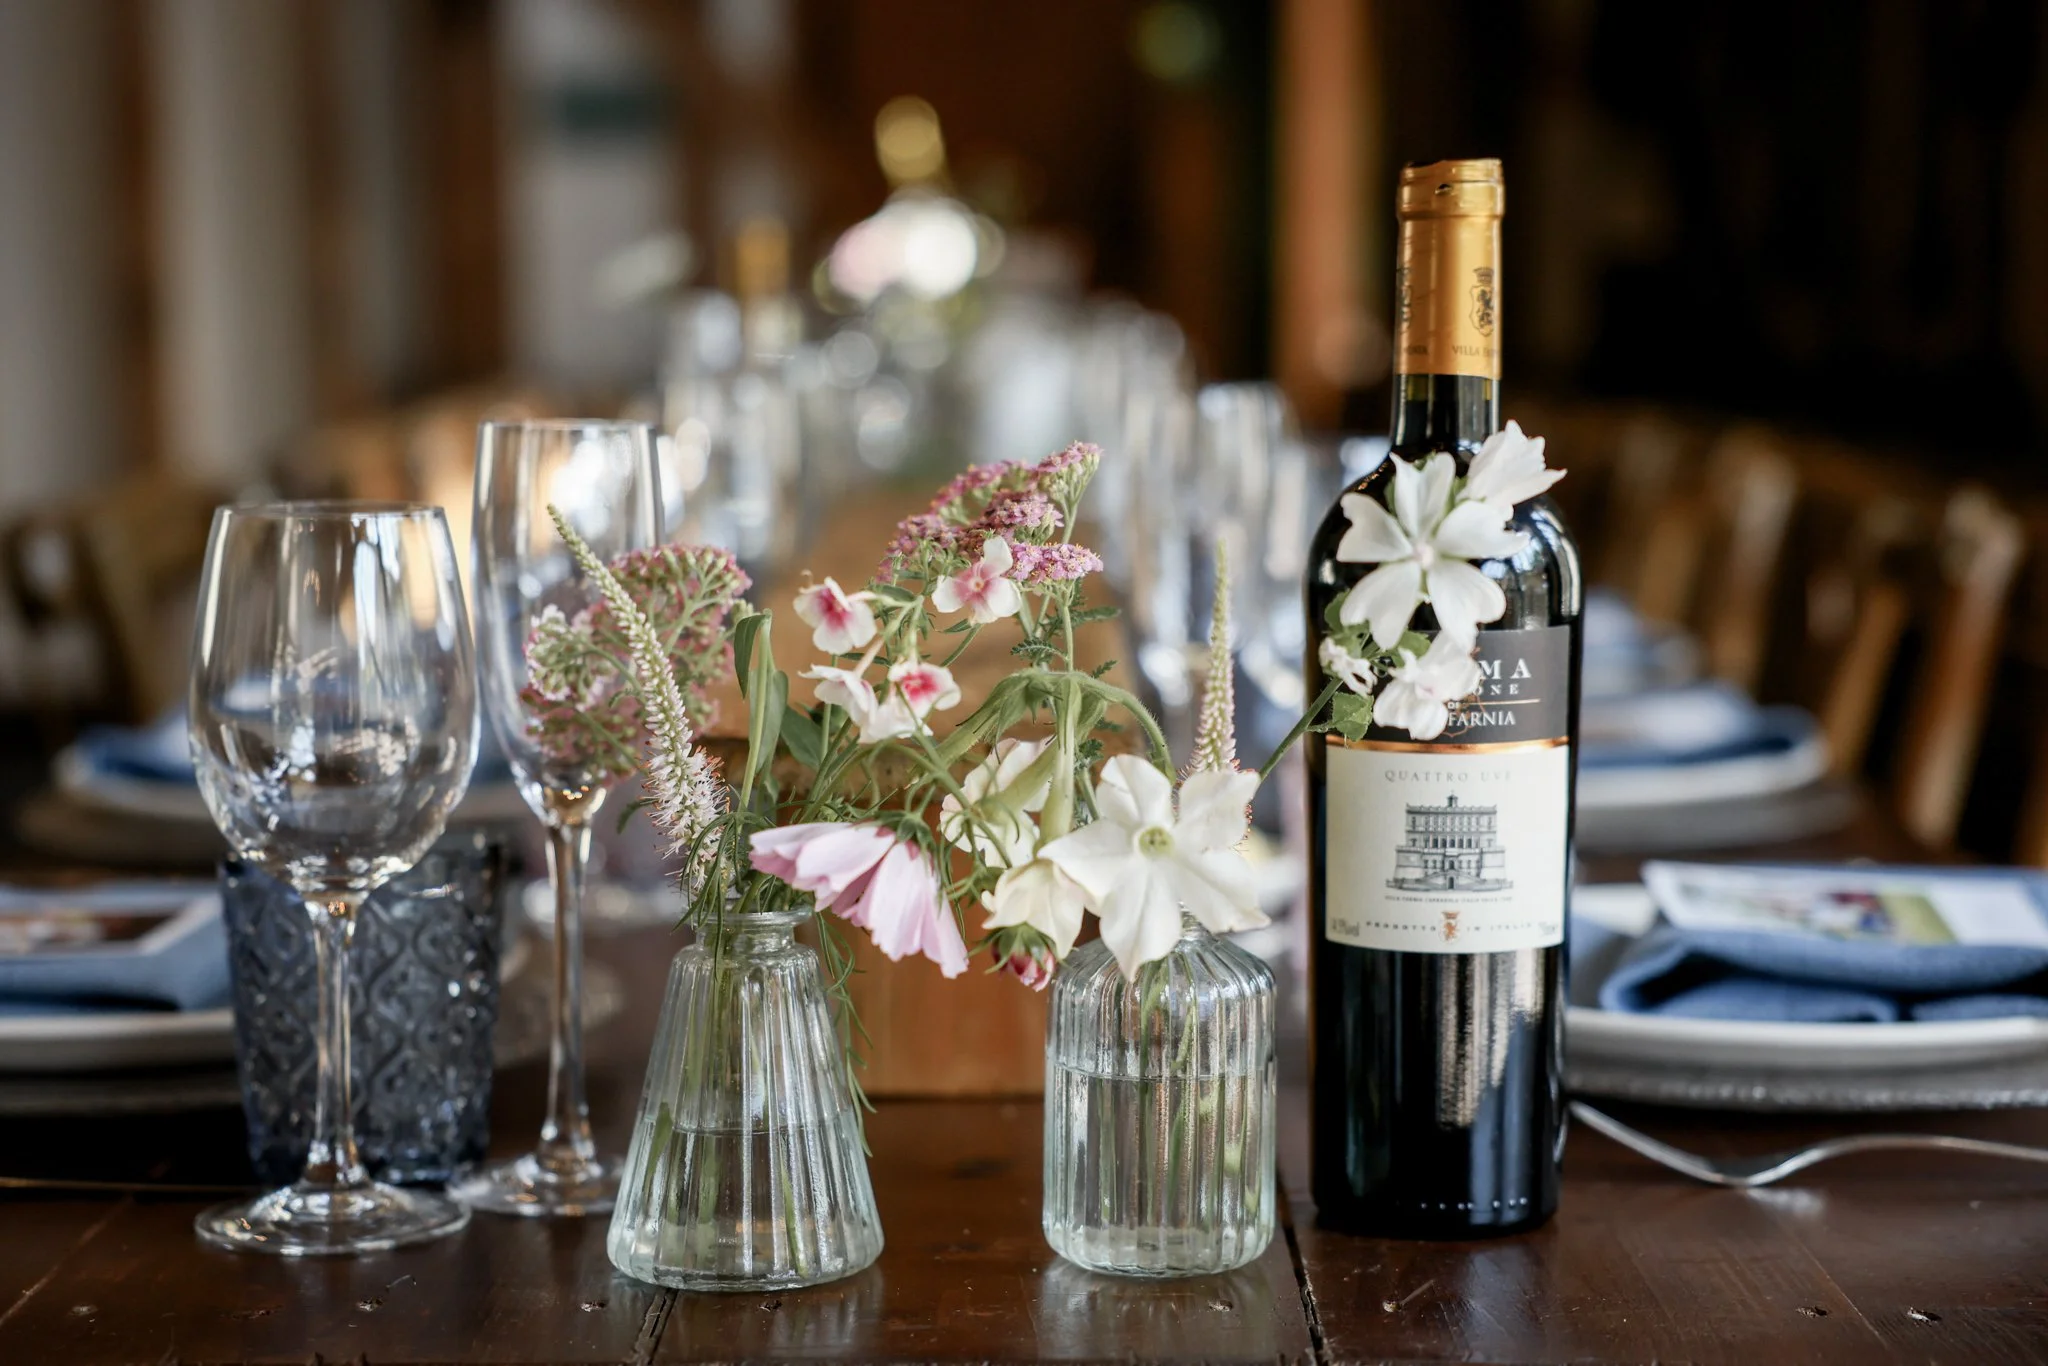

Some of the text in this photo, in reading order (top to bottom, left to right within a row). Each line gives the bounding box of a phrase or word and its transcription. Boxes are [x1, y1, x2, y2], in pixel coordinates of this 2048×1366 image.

[1450, 345, 1479, 356] VILLA
[1480, 657, 1532, 681] MA
[1448, 710, 1516, 727] FARNIA
[1383, 769, 1512, 783] QUATTRO UVE
